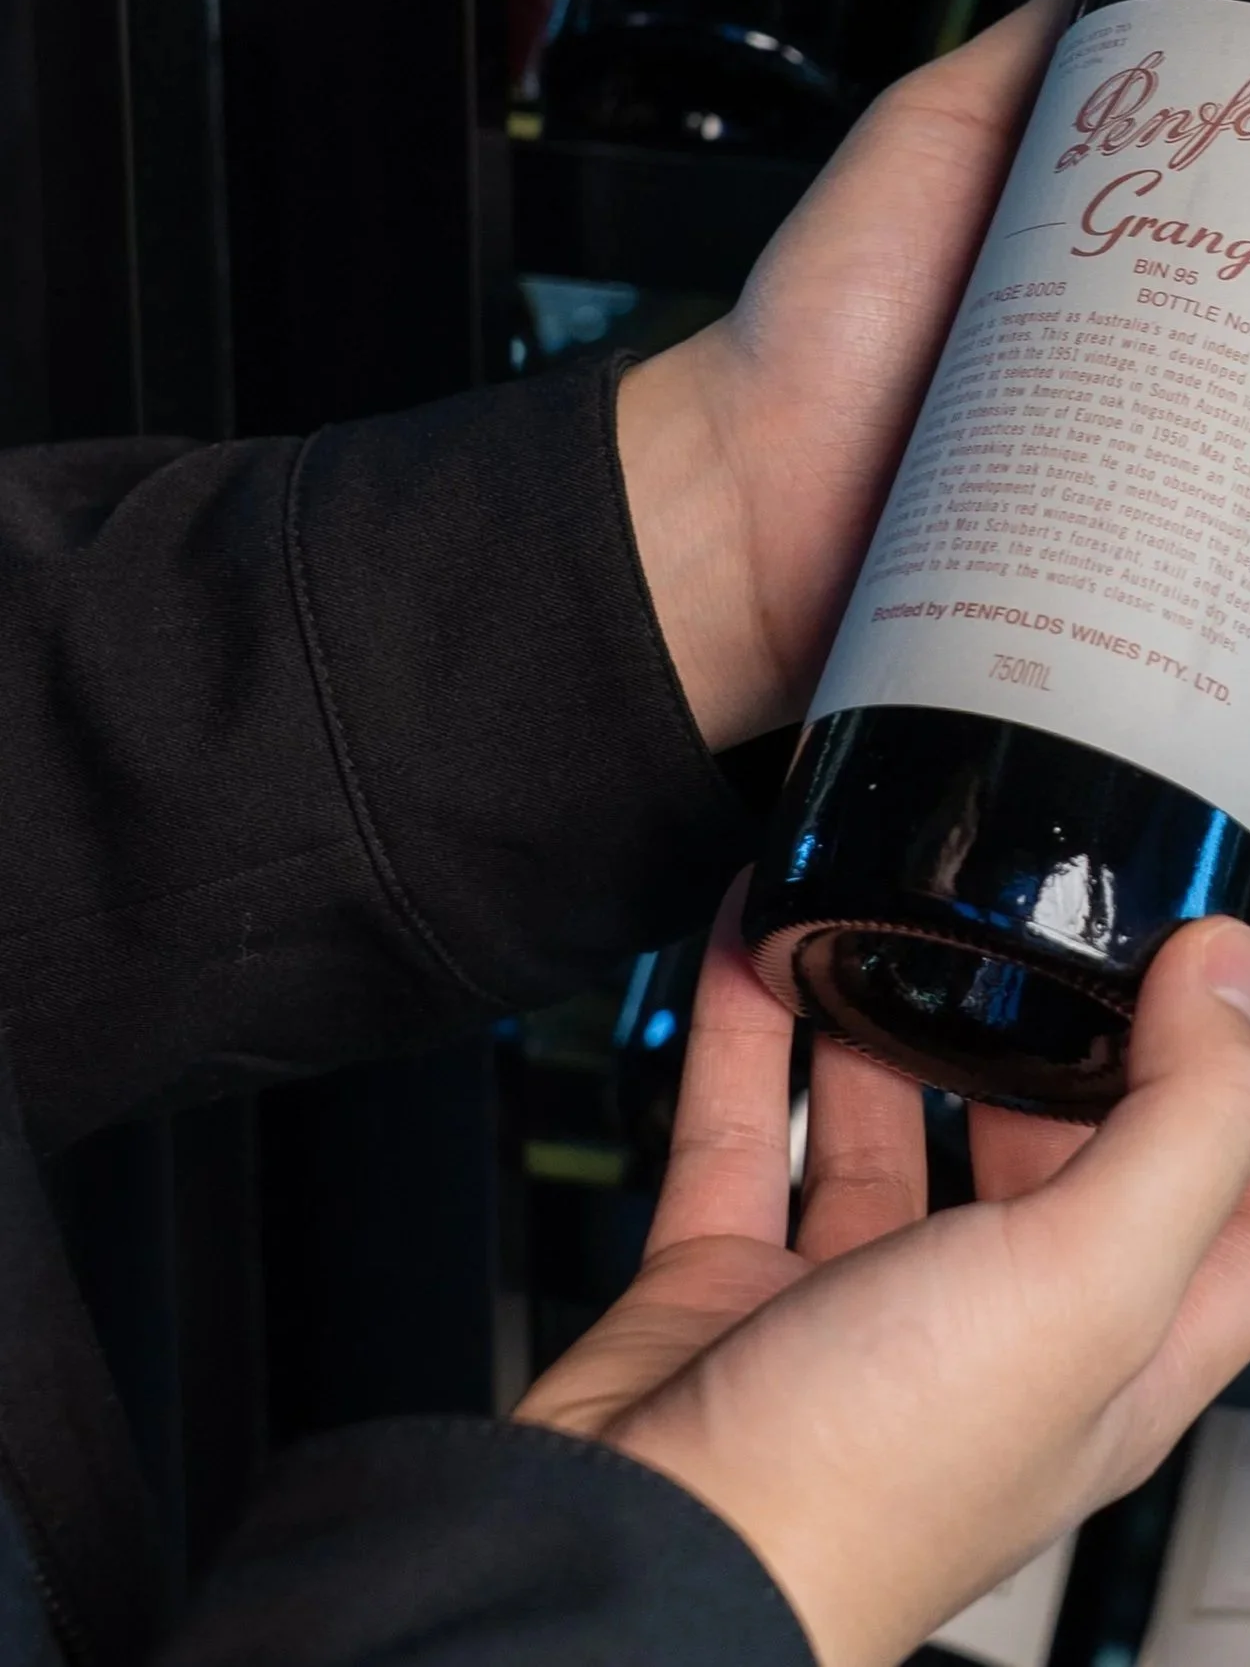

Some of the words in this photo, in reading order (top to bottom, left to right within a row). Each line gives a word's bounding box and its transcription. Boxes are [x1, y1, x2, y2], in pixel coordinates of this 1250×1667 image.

[1133, 258, 1171, 279] BIN
[1173, 267, 1200, 286] 95
[1137, 287, 1222, 323] BOTTLE
[1041, 327, 1070, 342] This
[1074, 331, 1115, 346] great
[1168, 349, 1246, 386] developed
[1065, 312, 1082, 323] as
[1086, 311, 1162, 336] Australia's
[1168, 327, 1198, 346] and
[1202, 336, 1250, 366] indeed
[1003, 367, 1054, 380] selected
[1058, 367, 1123, 389] vineyards
[1129, 380, 1144, 393] in
[1149, 382, 1191, 406] South
[1047, 346, 1080, 362] 1951
[1145, 363, 1158, 377] is
[1162, 368, 1202, 390] made
[1205, 377, 1240, 404] from
[1022, 405, 1051, 417] tour
[1054, 406, 1071, 419] of
[1074, 407, 1124, 430] Europe
[1129, 420, 1145, 435] in
[1199, 441, 1226, 464] Max
[1030, 384, 1094, 403] American
[1099, 394, 1125, 409] oak
[1131, 398, 1208, 435] hogsheads
[1214, 430, 1248, 451] prior
[1031, 422, 1061, 438] that
[1067, 427, 1102, 446] have
[1108, 437, 1137, 454] now
[1144, 445, 1201, 475] become
[1206, 470, 1225, 484] an
[1100, 453, 1119, 470] He
[1124, 463, 1156, 481] also
[1163, 474, 1226, 509] observed
[986, 462, 1011, 474] new
[1015, 462, 1039, 475] oak
[1107, 479, 1117, 491] a
[1125, 484, 1178, 512] method
[958, 478, 1036, 496] development
[1040, 484, 1057, 498] of
[1060, 486, 1113, 512] Grange
[1119, 504, 1203, 543] represented
[1207, 536, 1231, 556] the
[1015, 503, 1039, 516] red
[1042, 507, 1130, 540] winemaking
[1134, 530, 1198, 566] tradition.
[1207, 556, 1235, 582] This
[953, 518, 980, 532] Max
[984, 517, 1063, 542] Schubert's
[1069, 530, 1145, 568] foresight,
[1151, 559, 1188, 581] skill
[1192, 576, 1221, 598] and
[1007, 541, 1034, 557] the
[1038, 546, 1115, 577] definitive
[1120, 567, 1200, 611] Australian
[1205, 603, 1228, 626] dry
[965, 559, 1010, 577] among
[1016, 563, 1040, 579] the
[1045, 570, 1097, 594] world's
[1103, 585, 1157, 614] classic
[1161, 607, 1195, 630] wine
[1200, 623, 1239, 655] styles.
[871, 601, 925, 623] Bottled
[926, 601, 946, 620] by
[952, 601, 1064, 635] PENFOLDS
[1070, 622, 1142, 661] WINES
[1145, 650, 1189, 682] PTY.
[1193, 672, 1233, 705] LTD.
